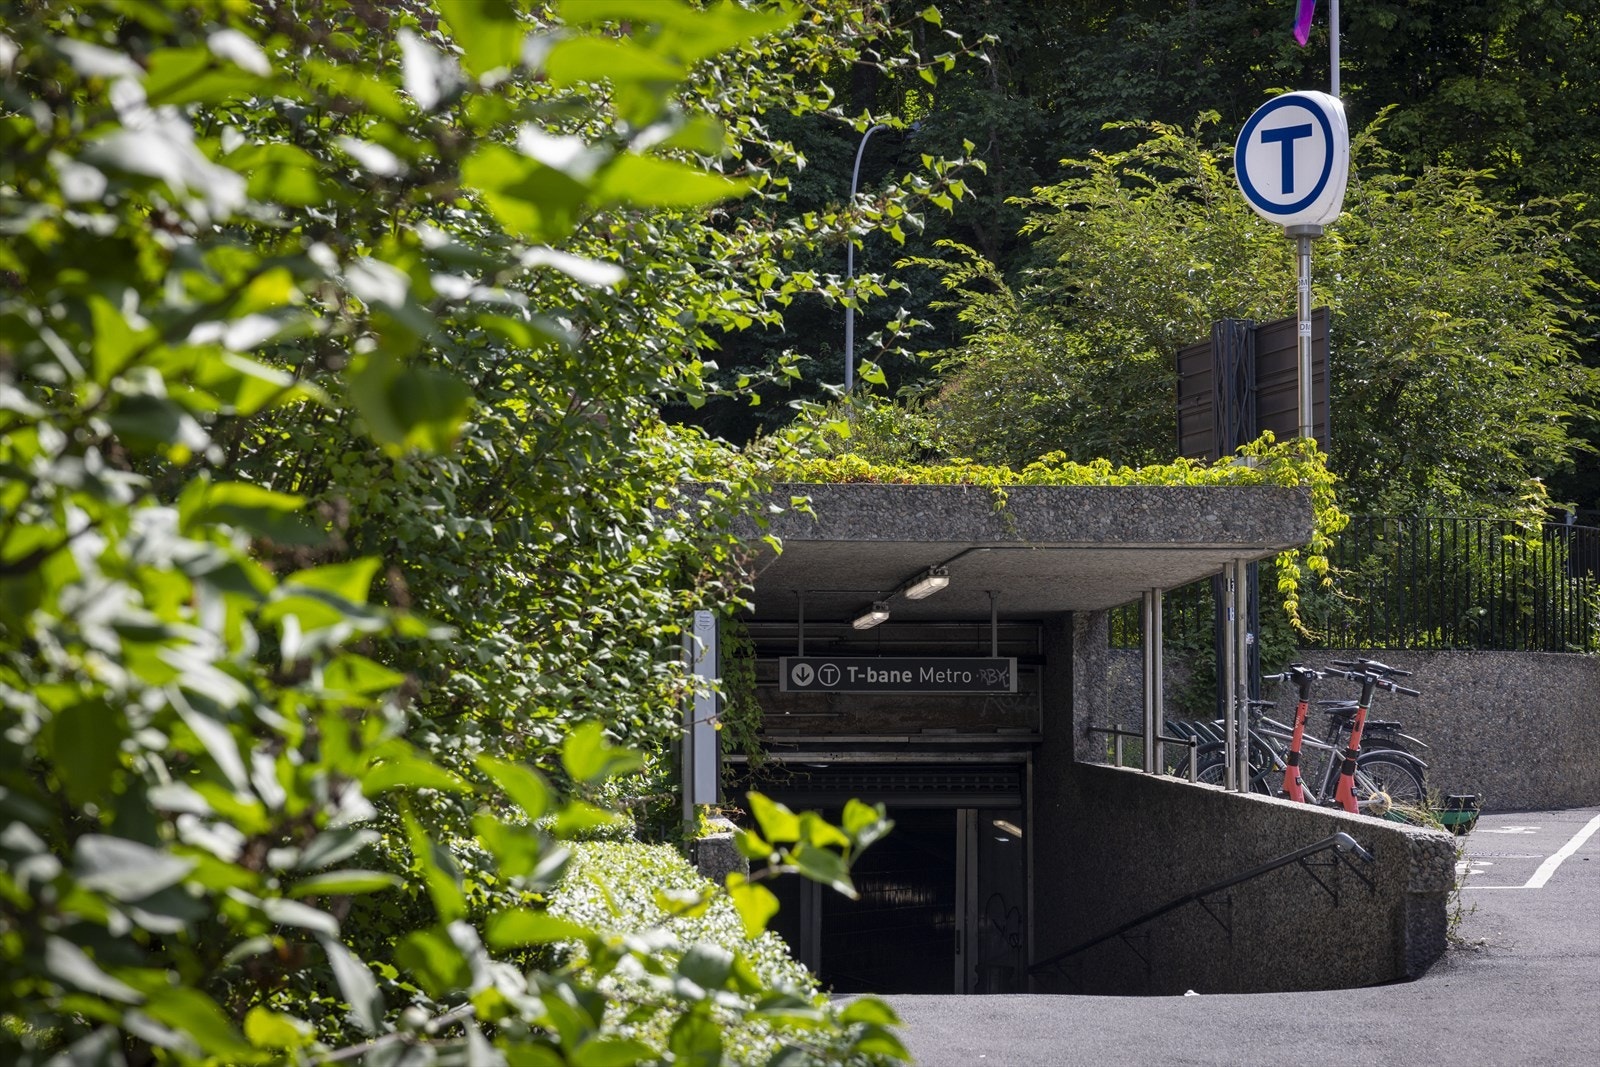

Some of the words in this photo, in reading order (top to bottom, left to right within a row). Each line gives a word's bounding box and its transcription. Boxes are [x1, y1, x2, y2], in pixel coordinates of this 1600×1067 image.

[1261, 123, 1312, 194] T
[847, 666, 912, 683] T-bane
[919, 666, 972, 683] Metro
